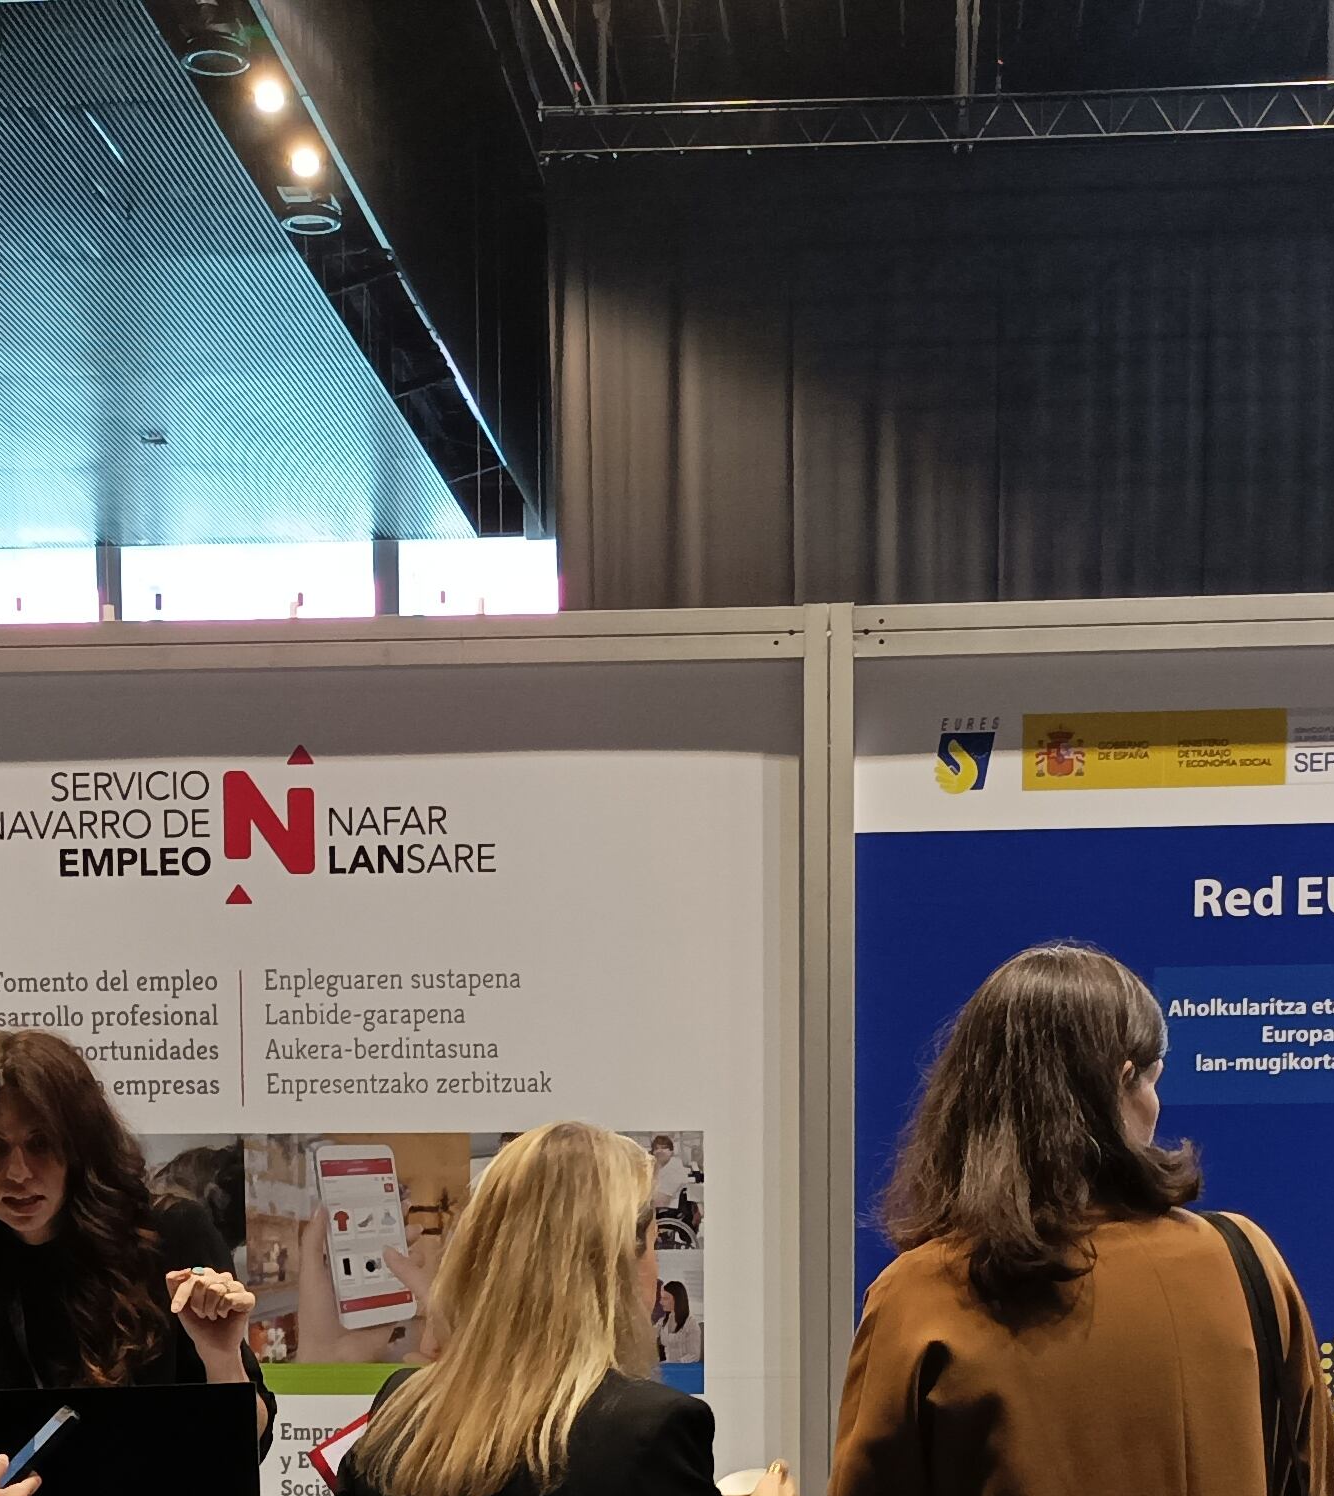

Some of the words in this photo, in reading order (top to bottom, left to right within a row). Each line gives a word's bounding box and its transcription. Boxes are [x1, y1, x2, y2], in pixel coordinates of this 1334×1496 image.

[941, 716, 1000, 731] EURES
[1098, 752, 1110, 760] DE
[51, 771, 209, 802] SERVICIO
[165, 809, 210, 838] DE
[329, 806, 447, 836] NAFAR
[60, 847, 211, 877] EMPLEO
[329, 844, 496, 875] LANSARE
[1193, 876, 1282, 918] Red
[96, 970, 128, 991] del
[137, 969, 218, 998] empleo
[265, 968, 403, 998] Enpleguaren
[411, 970, 521, 996] sustapena
[91, 1003, 218, 1034] profesional
[265, 1003, 465, 1032] Lanbide-garapena
[1169, 997, 1306, 1017] Aholkularitza
[265, 1037, 499, 1060] Aukera-berdintasuna
[114, 1076, 220, 1103] empresas
[267, 1072, 428, 1101] Enpresentzako
[437, 1071, 552, 1094] zerbitzuak
[280, 1456, 291, 1474] y
[281, 1479, 332, 1496] Socia
